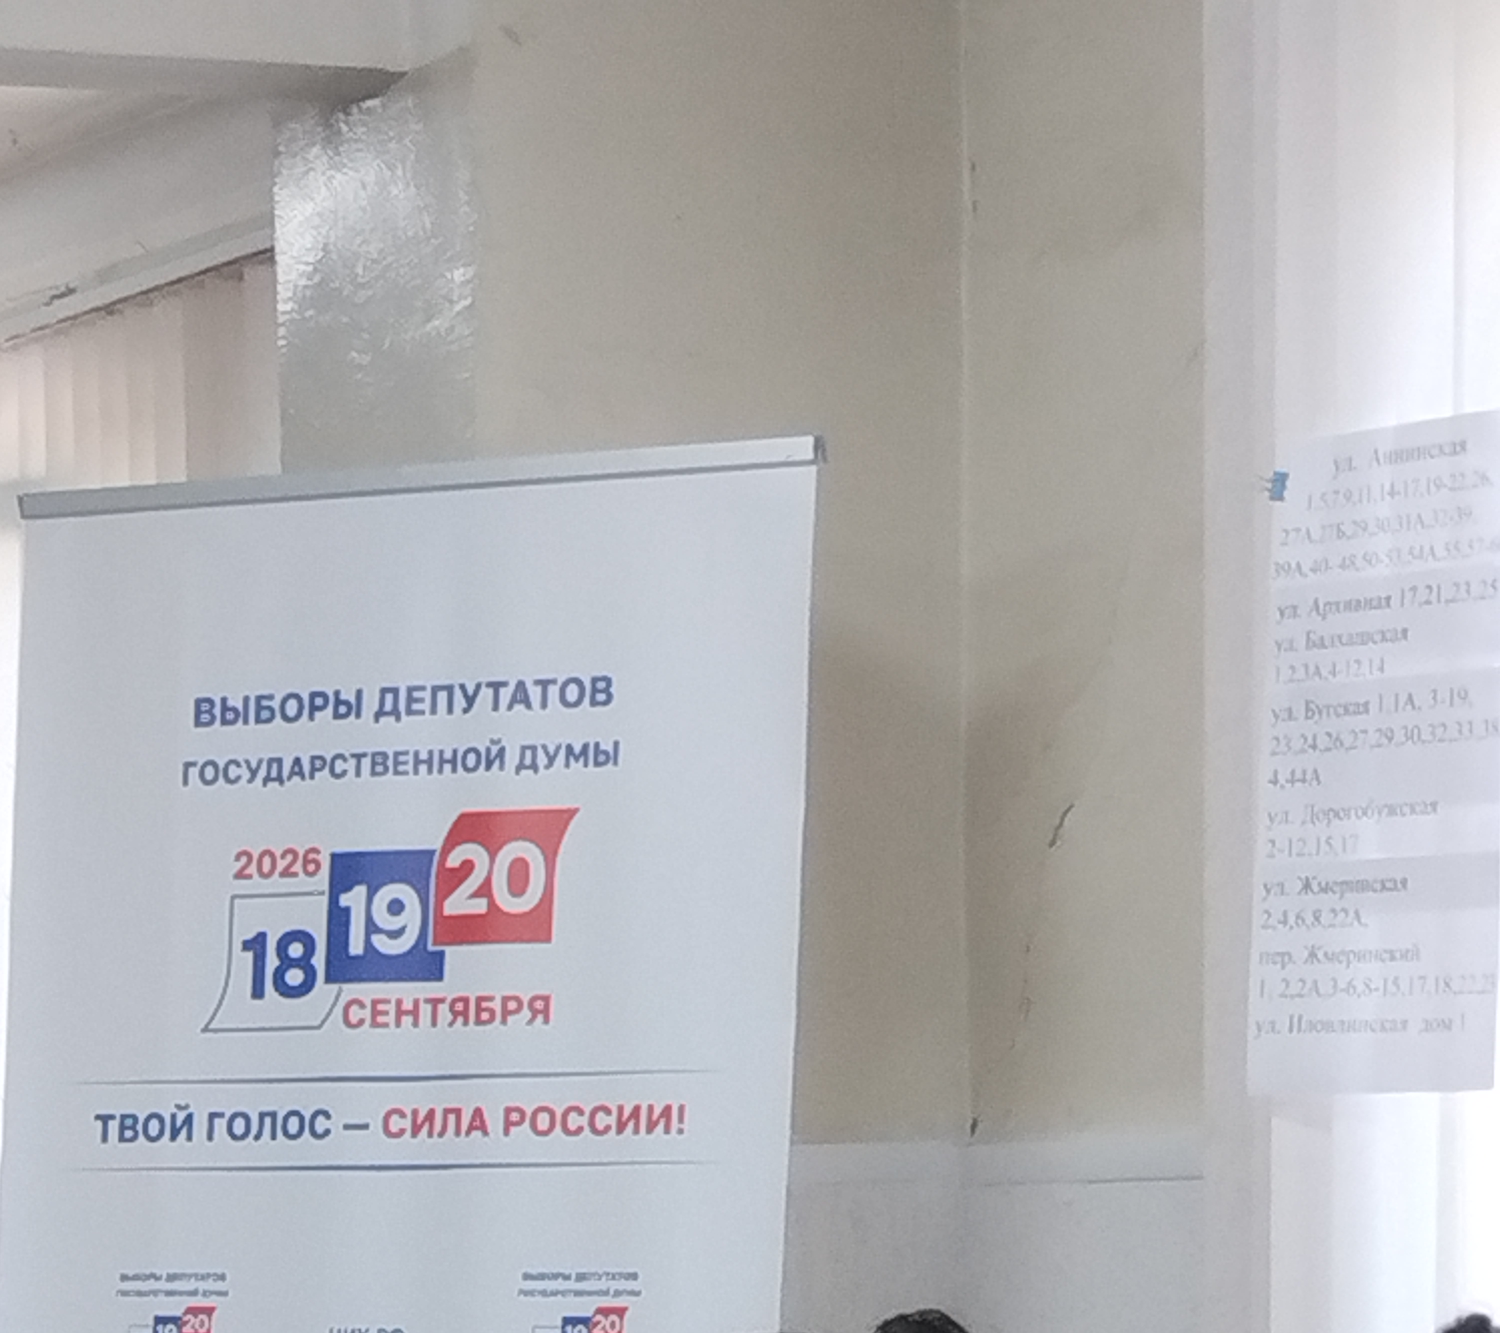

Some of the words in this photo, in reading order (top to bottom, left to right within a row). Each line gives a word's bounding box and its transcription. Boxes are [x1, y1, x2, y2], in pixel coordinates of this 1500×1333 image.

[1275, 605, 1301, 624] ул.
[1307, 594, 1392, 621] Архивная
[1274, 639, 1298, 657] ул.
[193, 688, 363, 729] ВЫБОРЫ
[374, 675, 615, 724] ДЕПУТАТОВ
[1271, 707, 1298, 728] ул.
[182, 737, 506, 787] ГОСУДАРСТВЕННОЙ
[515, 740, 620, 776] ДУМЫ
[1267, 810, 1294, 831] ул.
[1301, 798, 1438, 828] Дорогобужская
[233, 847, 322, 880] 2026
[441, 839, 547, 917] 20
[1262, 882, 1289, 901] ул.
[1297, 876, 1409, 900] Жмеринская
[338, 882, 423, 957] 19
[241, 929, 318, 1000] 18
[1259, 951, 1296, 969] пер.
[1303, 942, 1421, 968] Жмеринский
[341, 994, 552, 1030] СЕНТЯБРЯ
[1254, 1019, 1281, 1038] ул.
[1417, 1017, 1453, 1034] дом
[95, 1104, 196, 1145] ТВОЙ
[206, 1107, 332, 1143] ГОЛОС
[381, 1106, 490, 1140] СИЛА
[502, 1103, 687, 1138] РОССИИ!
[182, 1313, 209, 1333] 20
